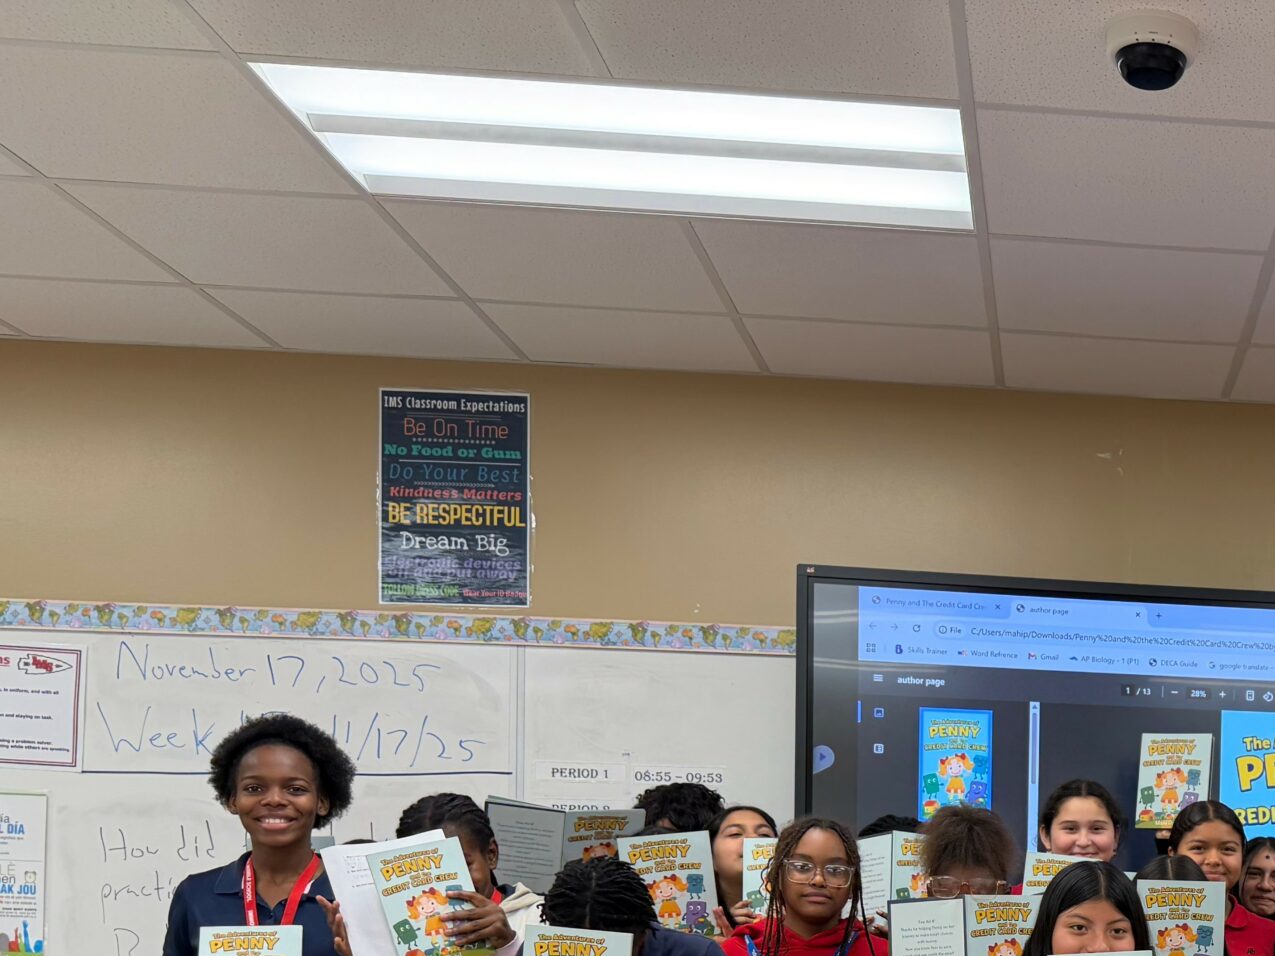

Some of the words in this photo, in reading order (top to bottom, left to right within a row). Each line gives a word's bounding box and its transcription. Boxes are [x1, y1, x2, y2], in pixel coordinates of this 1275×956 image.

[384, 396, 403, 408] IMS
[406, 397, 457, 410] Classroom
[460, 399, 526, 413] Expectations
[404, 418, 426, 436] Be
[434, 418, 458, 437] On
[465, 420, 509, 439] Time
[384, 444, 407, 455] No
[411, 444, 453, 458] Food
[458, 448, 478, 458] or
[481, 447, 522, 460] Gum
[389, 464, 414, 480] Do
[423, 465, 469, 481] Your
[478, 466, 520, 483] Best
[390, 486, 458, 499] Kindness
[463, 489, 523, 501] Matters
[388, 502, 411, 526] BE
[416, 504, 526, 527] RESPECTFUL
[400, 531, 469, 550] Dream
[476, 534, 510, 556] Big
[463, 558, 521, 570] devices
[414, 567, 443, 578] and
[447, 568, 473, 580] put
[477, 569, 517, 583] away
[886, 598, 906, 608] Penny
[907, 599, 921, 608] and
[922, 600, 935, 608] The
[936, 601, 955, 609] Credit
[956, 602, 971, 610] Card
[1029, 606, 1051, 616] author
[1052, 608, 1069, 617] page
[950, 626, 962, 635] File
[908, 646, 924, 655] Skills
[926, 647, 948, 656] Trainer
[970, 650, 989, 658] Word
[990, 650, 1018, 659] Refrence
[1040, 652, 1060, 661] Gmail
[116, 641, 258, 683] November
[1081, 655, 1090, 663] AP
[1091, 655, 1116, 665] Biology
[1160, 660, 1178, 668] DECA
[1179, 661, 1198, 669] Guide
[1219, 663, 1242, 672] google
[897, 676, 925, 686] author
[925, 678, 945, 688] page
[1190, 689, 1207, 699] 28%
[97, 701, 216, 756] Week
[929, 726, 981, 739] PENNY
[1148, 744, 1197, 756] PENNY
[1243, 736, 1272, 751] The
[551, 767, 598, 780] PERIOD
[603, 769, 609, 780] 1
[634, 770, 672, 783] 08:55
[685, 771, 723, 784] 09:53
[7, 820, 25, 835] DÍA
[574, 820, 629, 832] PENNY
[100, 826, 159, 863] How
[177, 820, 217, 862] did
[628, 845, 692, 865] PENNY
[380, 854, 444, 882] PENNY
[678, 862, 702, 870] CREW
[17, 884, 37, 896] JOU
[382, 882, 410, 898] CREDIT
[434, 872, 459, 883] CREW
[101, 870, 174, 924] practi
[1145, 893, 1207, 908] PENNY
[975, 908, 1032, 924] PENNY
[1190, 913, 1215, 922] CREW
[553, 934, 596, 944] Adventures
[971, 928, 996, 938] CREDIT
[209, 937, 280, 953] PENNY
